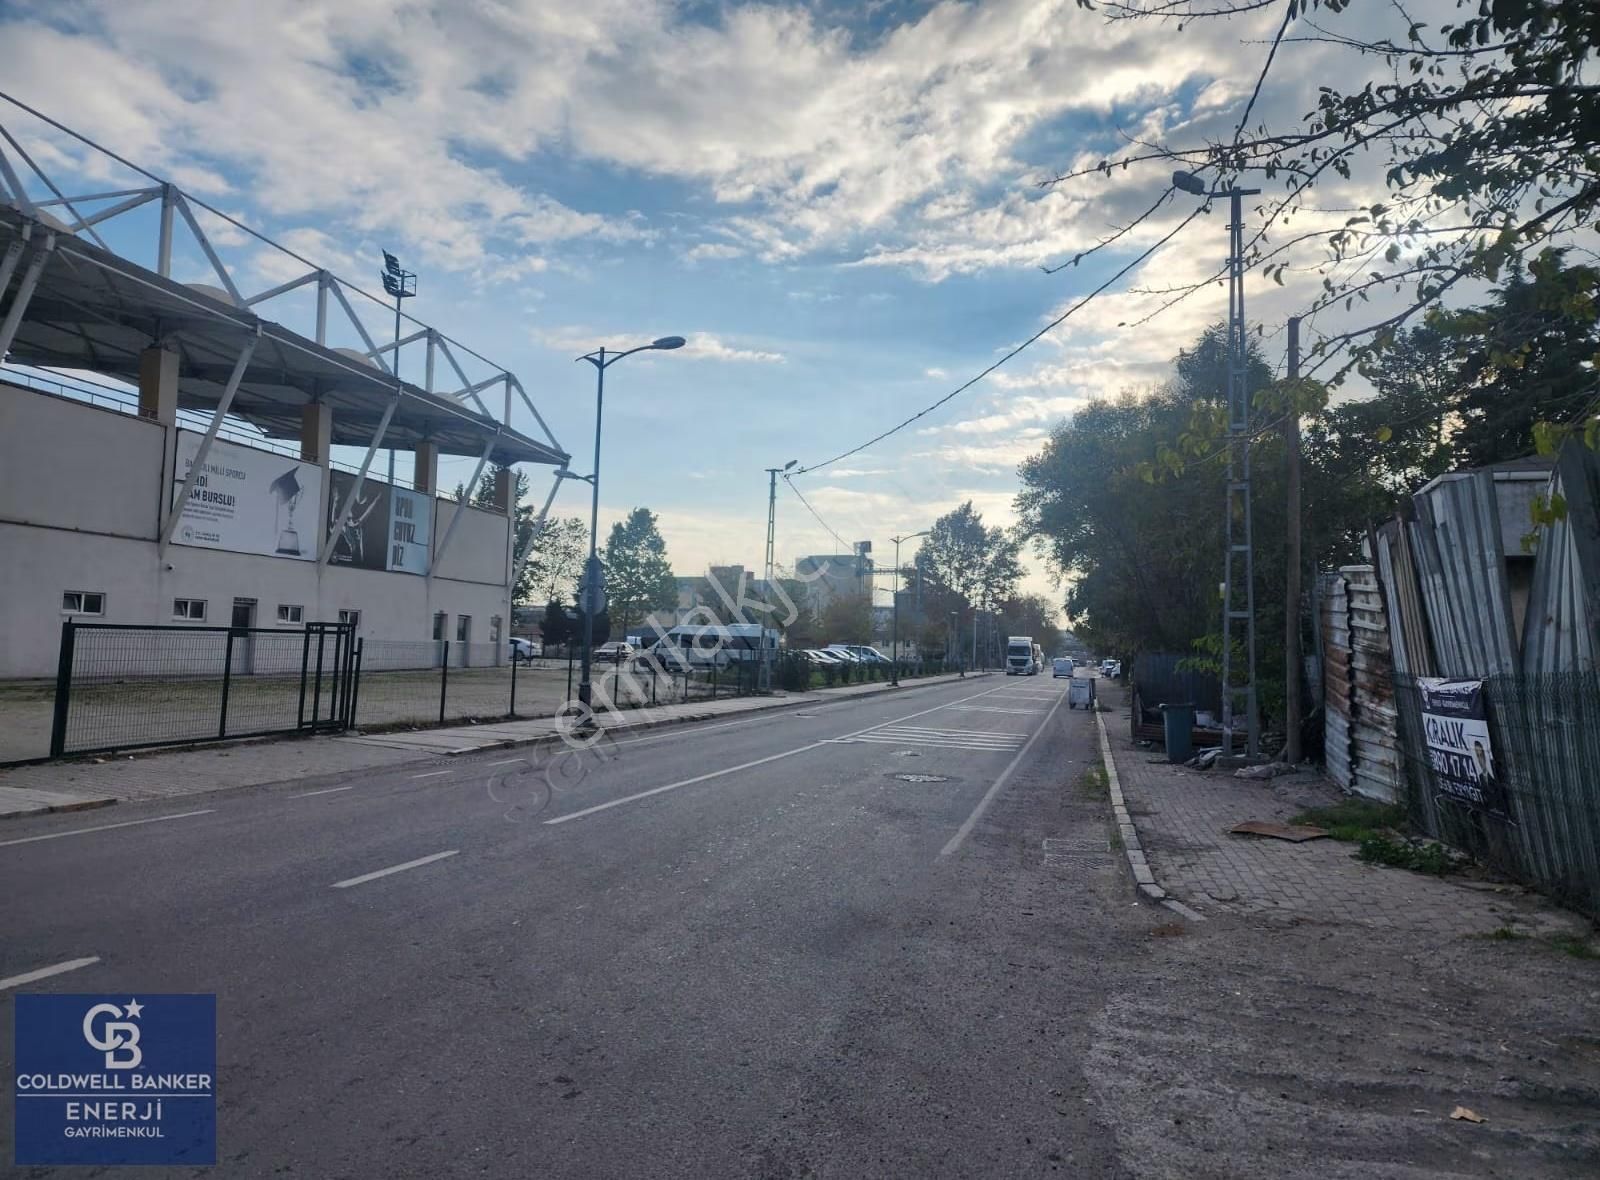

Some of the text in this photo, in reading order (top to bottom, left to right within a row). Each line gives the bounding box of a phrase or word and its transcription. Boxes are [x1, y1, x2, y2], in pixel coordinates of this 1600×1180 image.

[202, 490, 235, 507] BURSLU!
[1450, 754, 1461, 778] 17
[1463, 757, 1478, 783] 14
